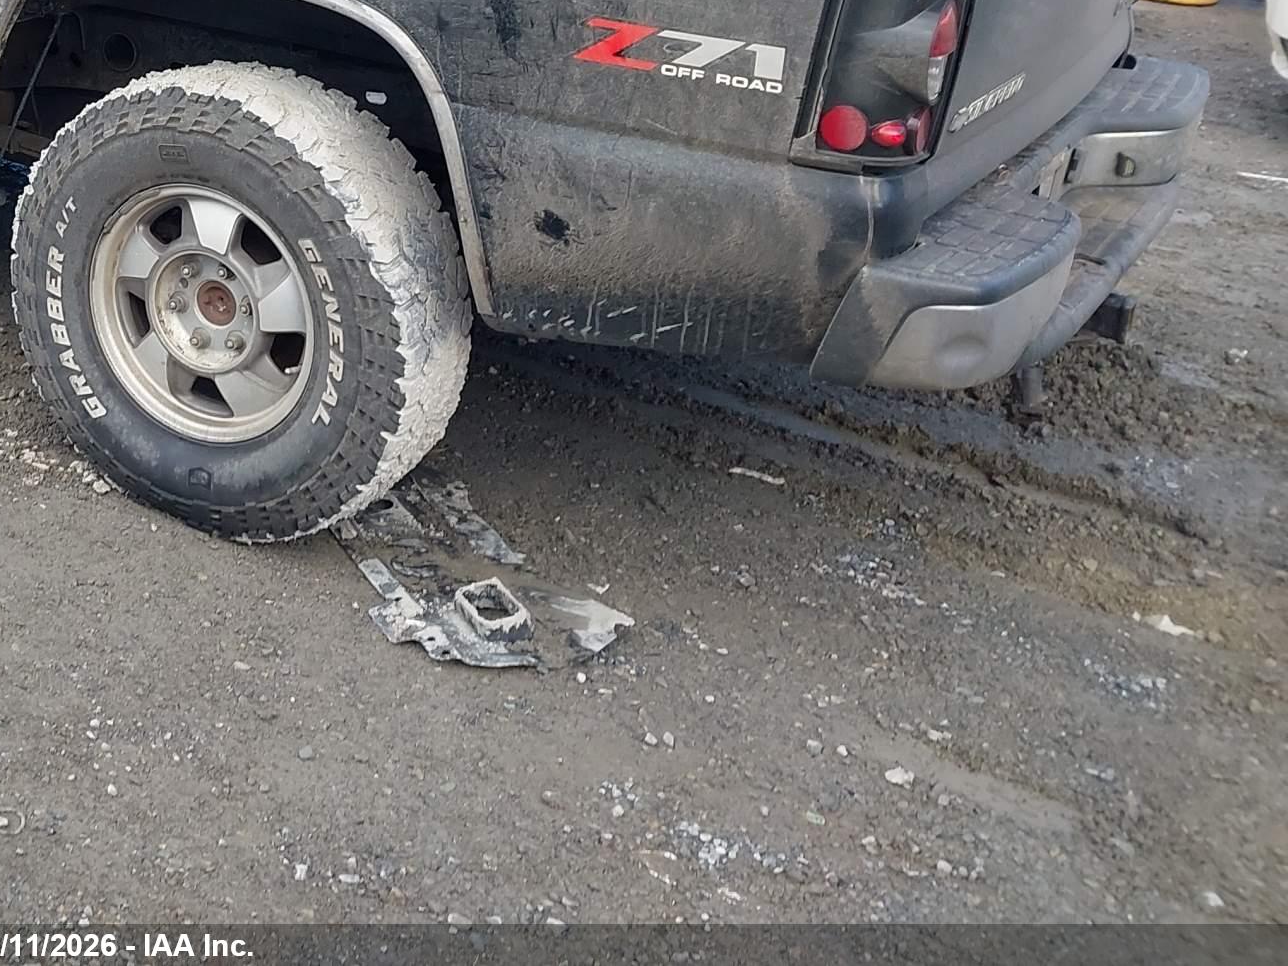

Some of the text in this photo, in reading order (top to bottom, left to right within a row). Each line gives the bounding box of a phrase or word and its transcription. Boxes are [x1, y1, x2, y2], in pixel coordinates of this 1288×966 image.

[573, 16, 786, 80] Z71
[660, 63, 783, 94] OFF ROAD
[46, 196, 107, 419] GRABBER A/T
[298, 238, 345, 426] GENERAL
